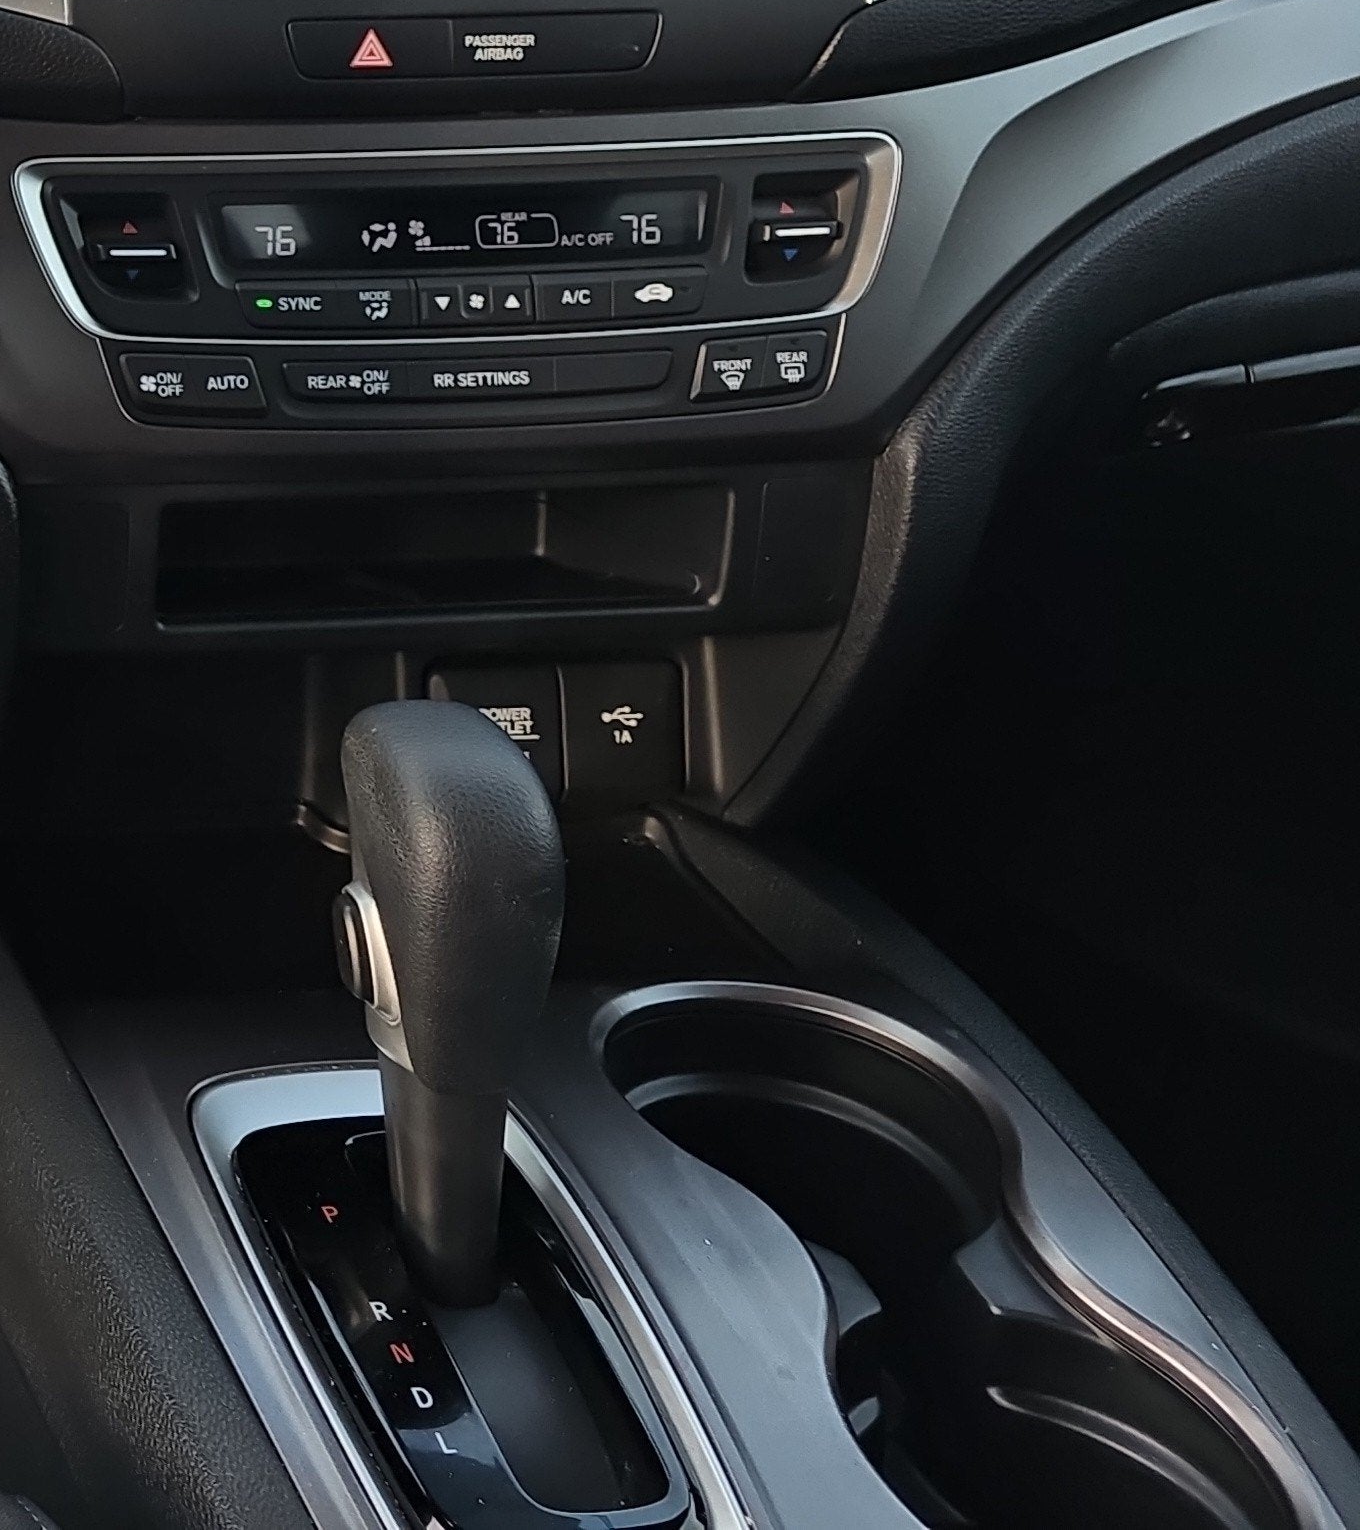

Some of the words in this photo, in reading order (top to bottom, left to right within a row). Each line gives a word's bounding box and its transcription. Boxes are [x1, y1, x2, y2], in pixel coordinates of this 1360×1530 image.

[464, 34, 535, 48] PASSENGER
[474, 47, 524, 61] AIRBAG
[500, 212, 528, 221] REAR
[488, 222, 519, 245] 76
[619, 214, 661, 245] 76
[254, 225, 296, 256] 76
[560, 233, 585, 247] A/C
[587, 232, 614, 246] OFF
[358, 291, 392, 302] MODE
[561, 290, 591, 304] A/C
[277, 297, 322, 311] SYNC
[775, 351, 808, 363] REAR
[712, 359, 752, 372] FRONT
[206, 375, 249, 390] AUTO
[307, 375, 346, 389] REAR
[433, 373, 455, 388] RR
[457, 371, 530, 387] SETTINGS
[157, 384, 183, 397] OFF
[363, 382, 390, 395] OFF
[613, 730, 633, 744] 1A
[320, 1205, 339, 1224] P
[368, 1301, 393, 1322] R
[389, 1343, 415, 1364] N
[410, 1387, 434, 1409] D
[435, 1432, 458, 1455] L
